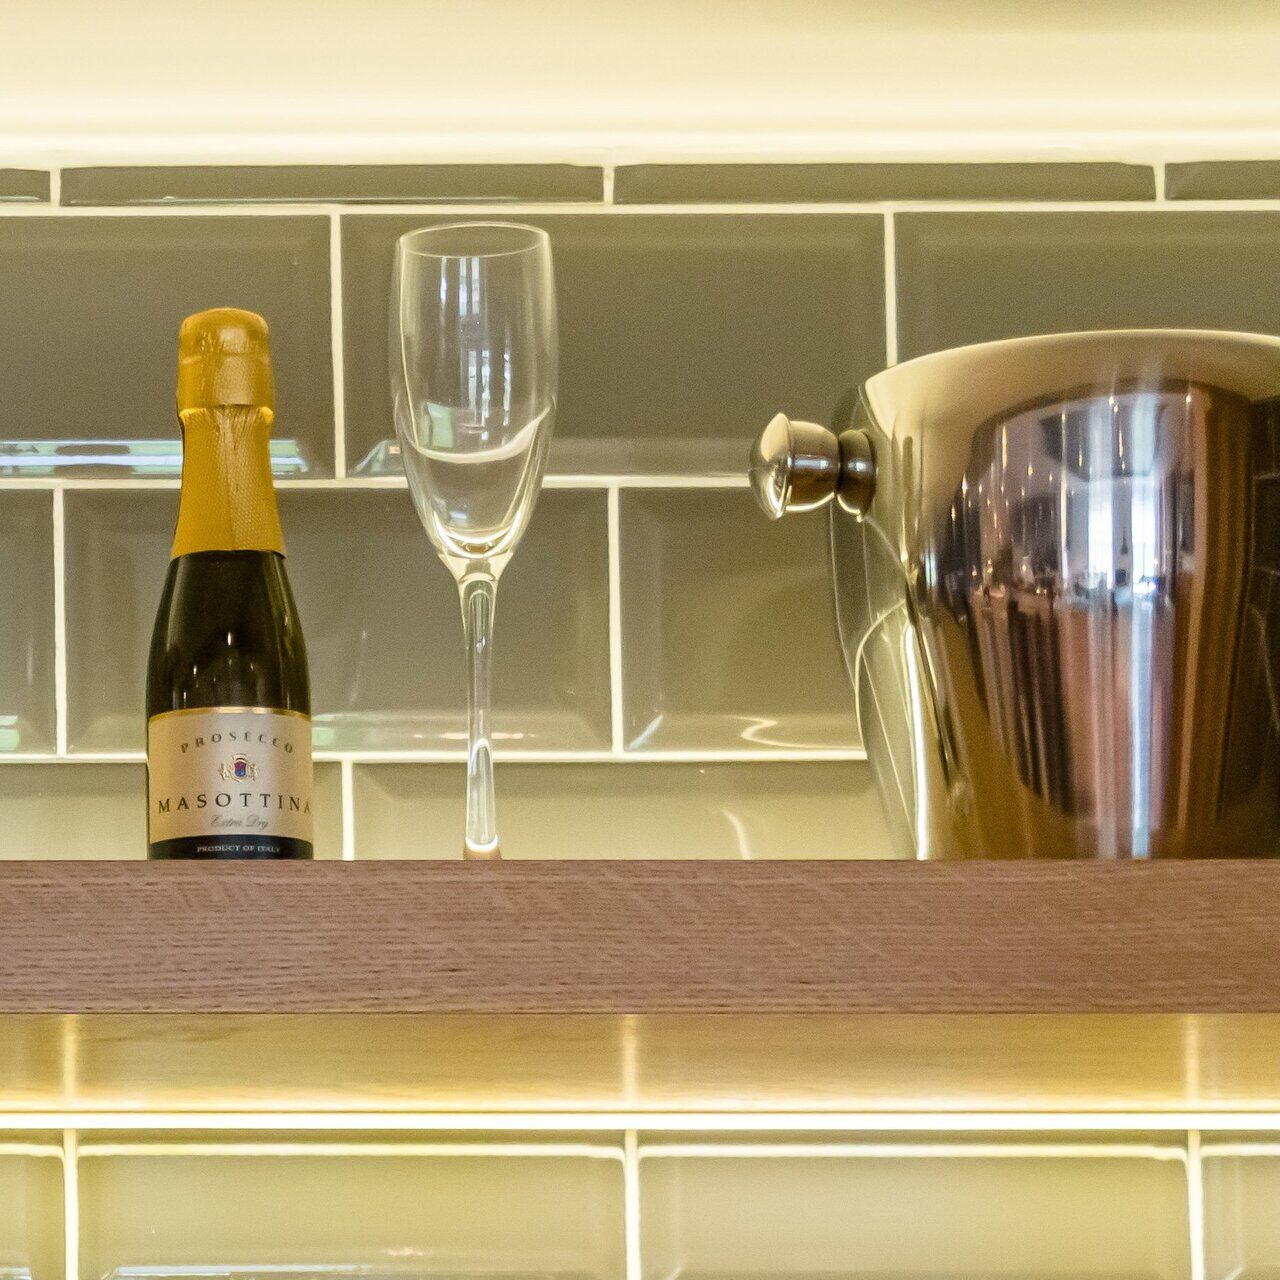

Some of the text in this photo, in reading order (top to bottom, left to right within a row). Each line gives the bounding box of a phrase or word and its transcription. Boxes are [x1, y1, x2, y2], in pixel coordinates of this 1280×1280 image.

[180, 731, 294, 754] PROSECCO
[158, 792, 311, 814] MASOTTINA
[245, 814, 269, 831] Dry
